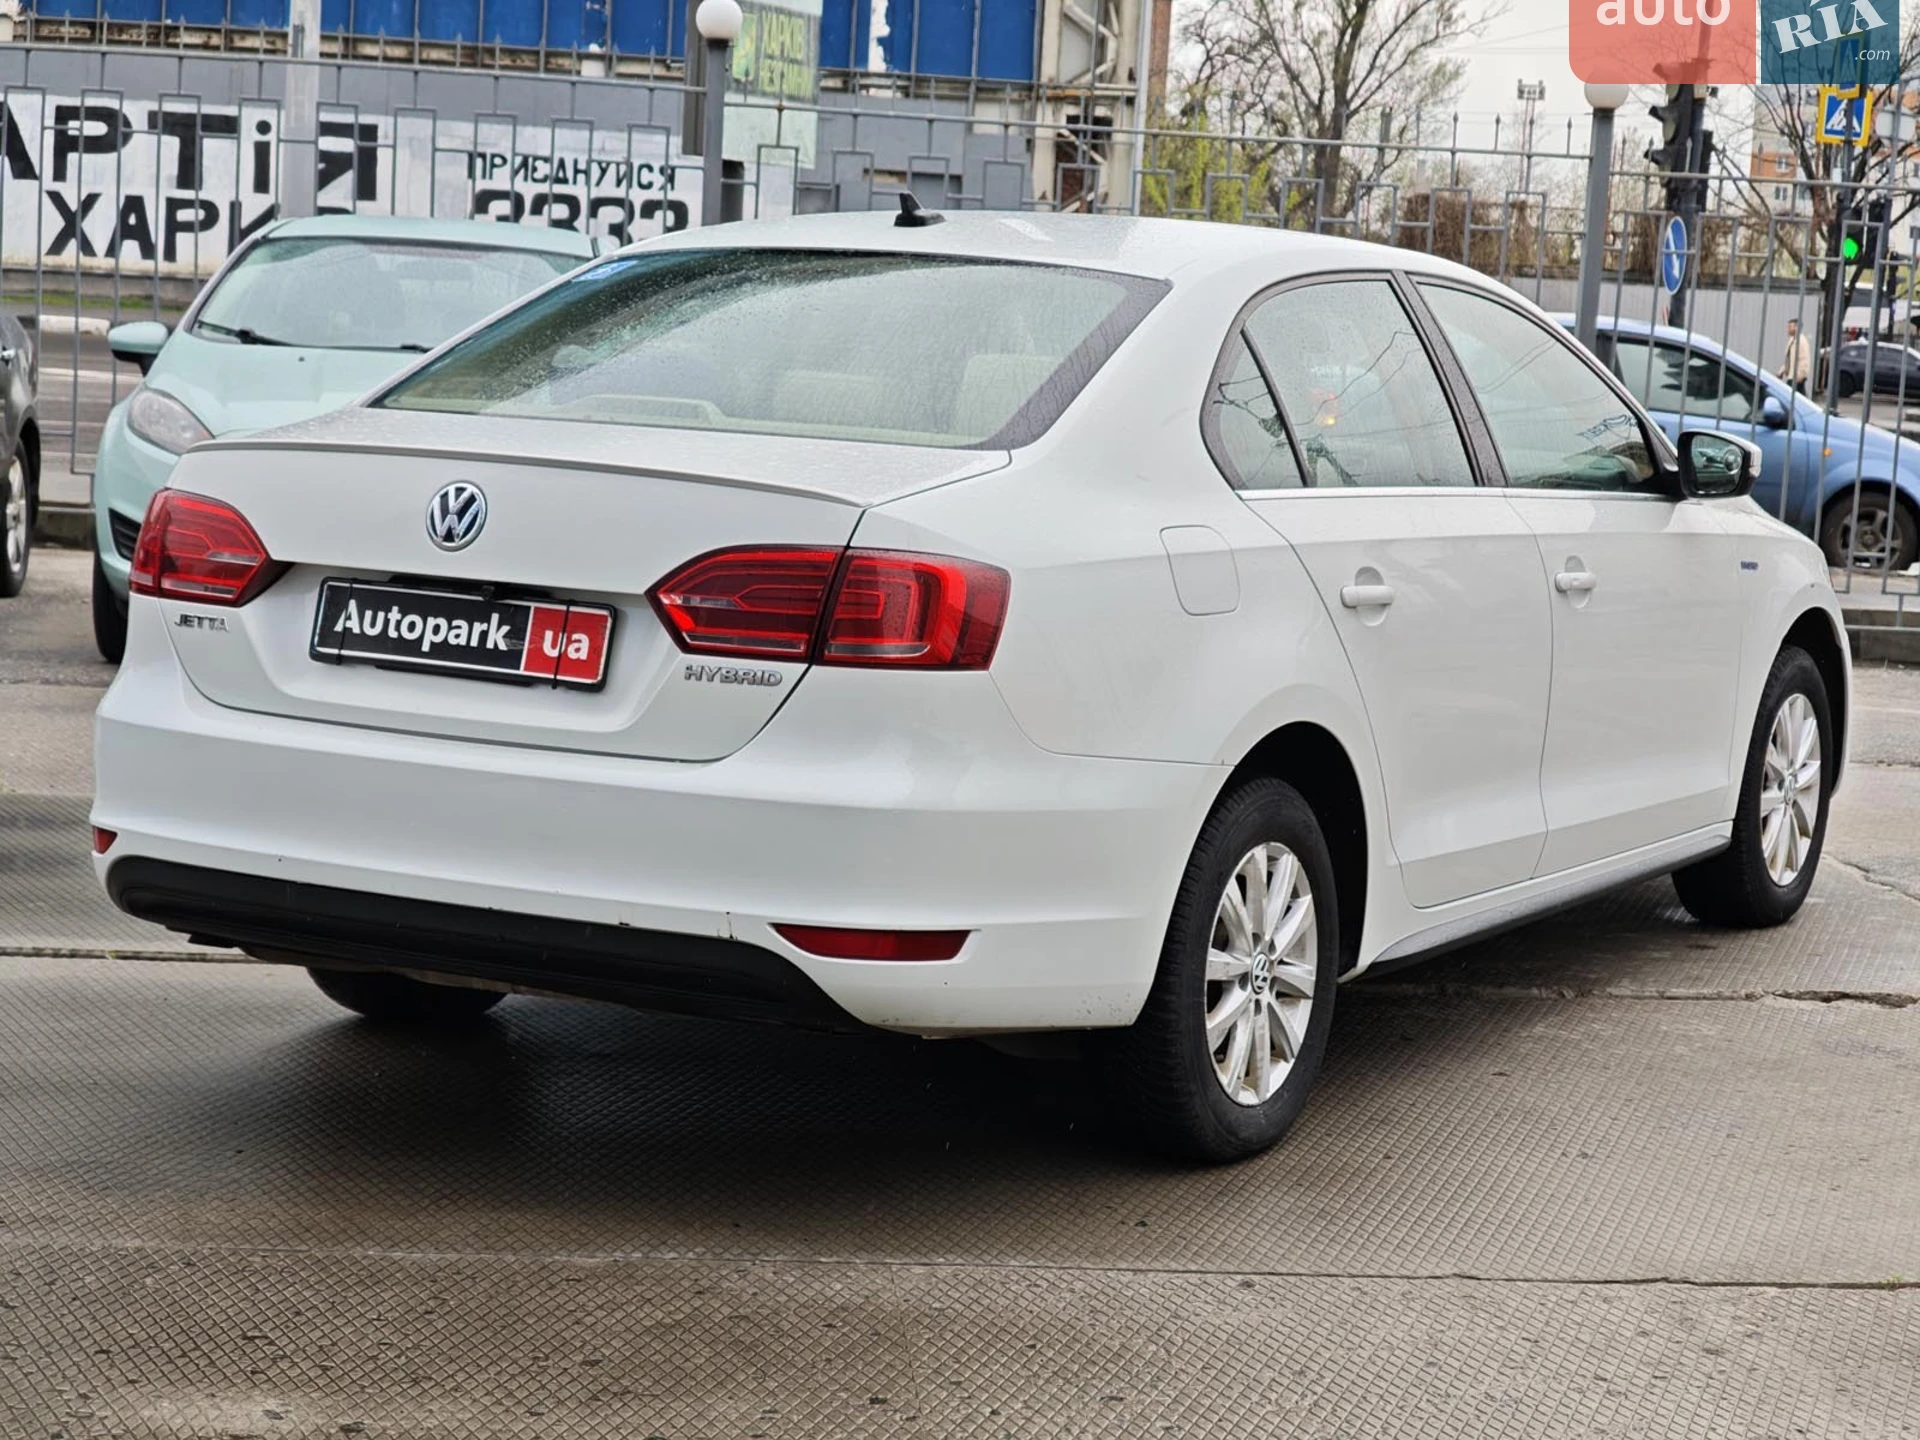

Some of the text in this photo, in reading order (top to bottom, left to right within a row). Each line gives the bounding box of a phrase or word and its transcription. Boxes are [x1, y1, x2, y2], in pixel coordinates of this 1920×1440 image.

[174, 613, 229, 632] JETTA
[333, 598, 590, 661] Autopark ua
[684, 664, 783, 687] HYBRID
